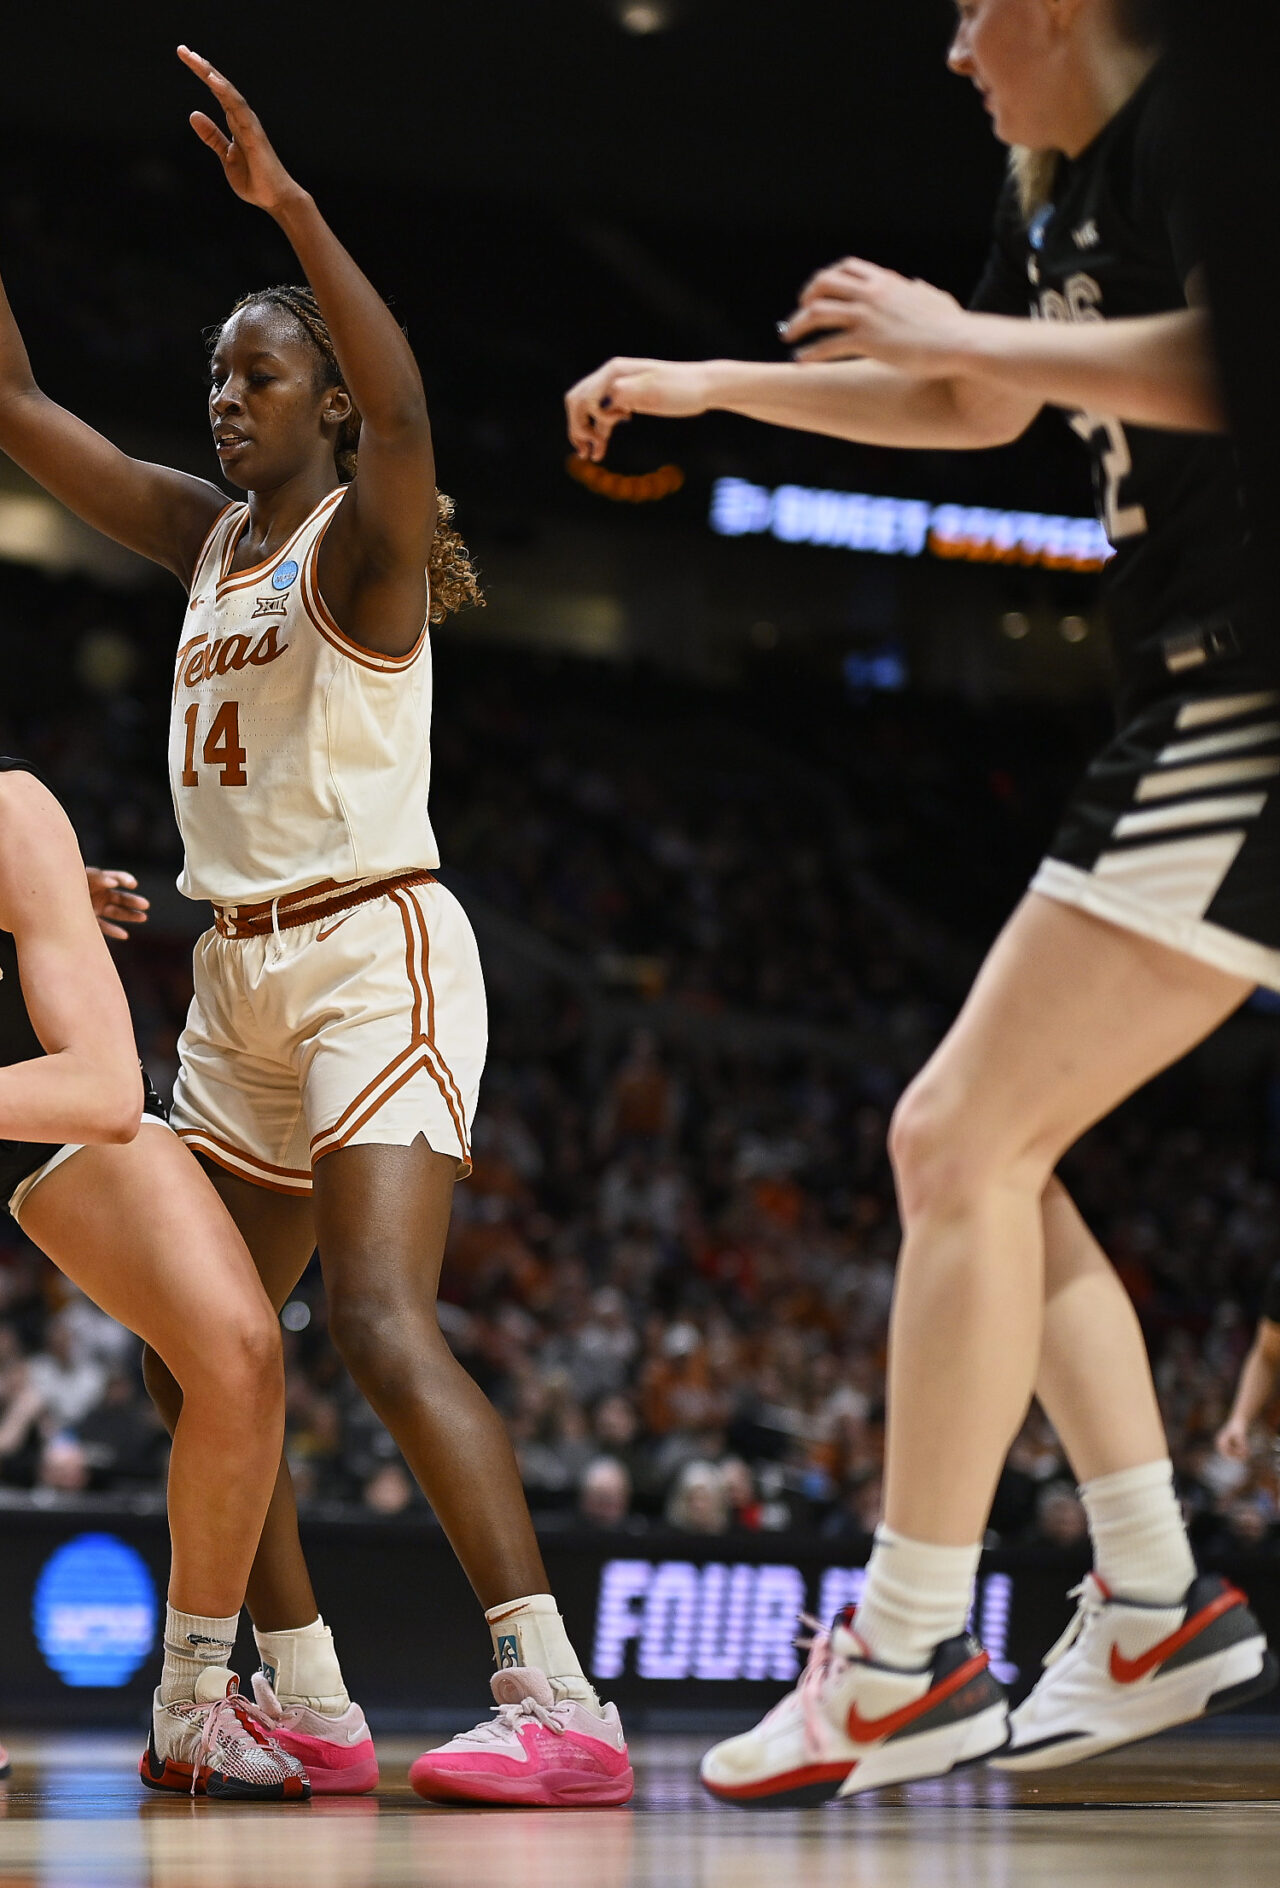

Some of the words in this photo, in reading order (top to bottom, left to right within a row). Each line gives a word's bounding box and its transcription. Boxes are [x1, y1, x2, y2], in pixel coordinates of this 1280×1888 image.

[176, 626, 289, 704] Texas
[182, 701, 247, 787] 14
[593, 1558, 807, 1680] FOUR
